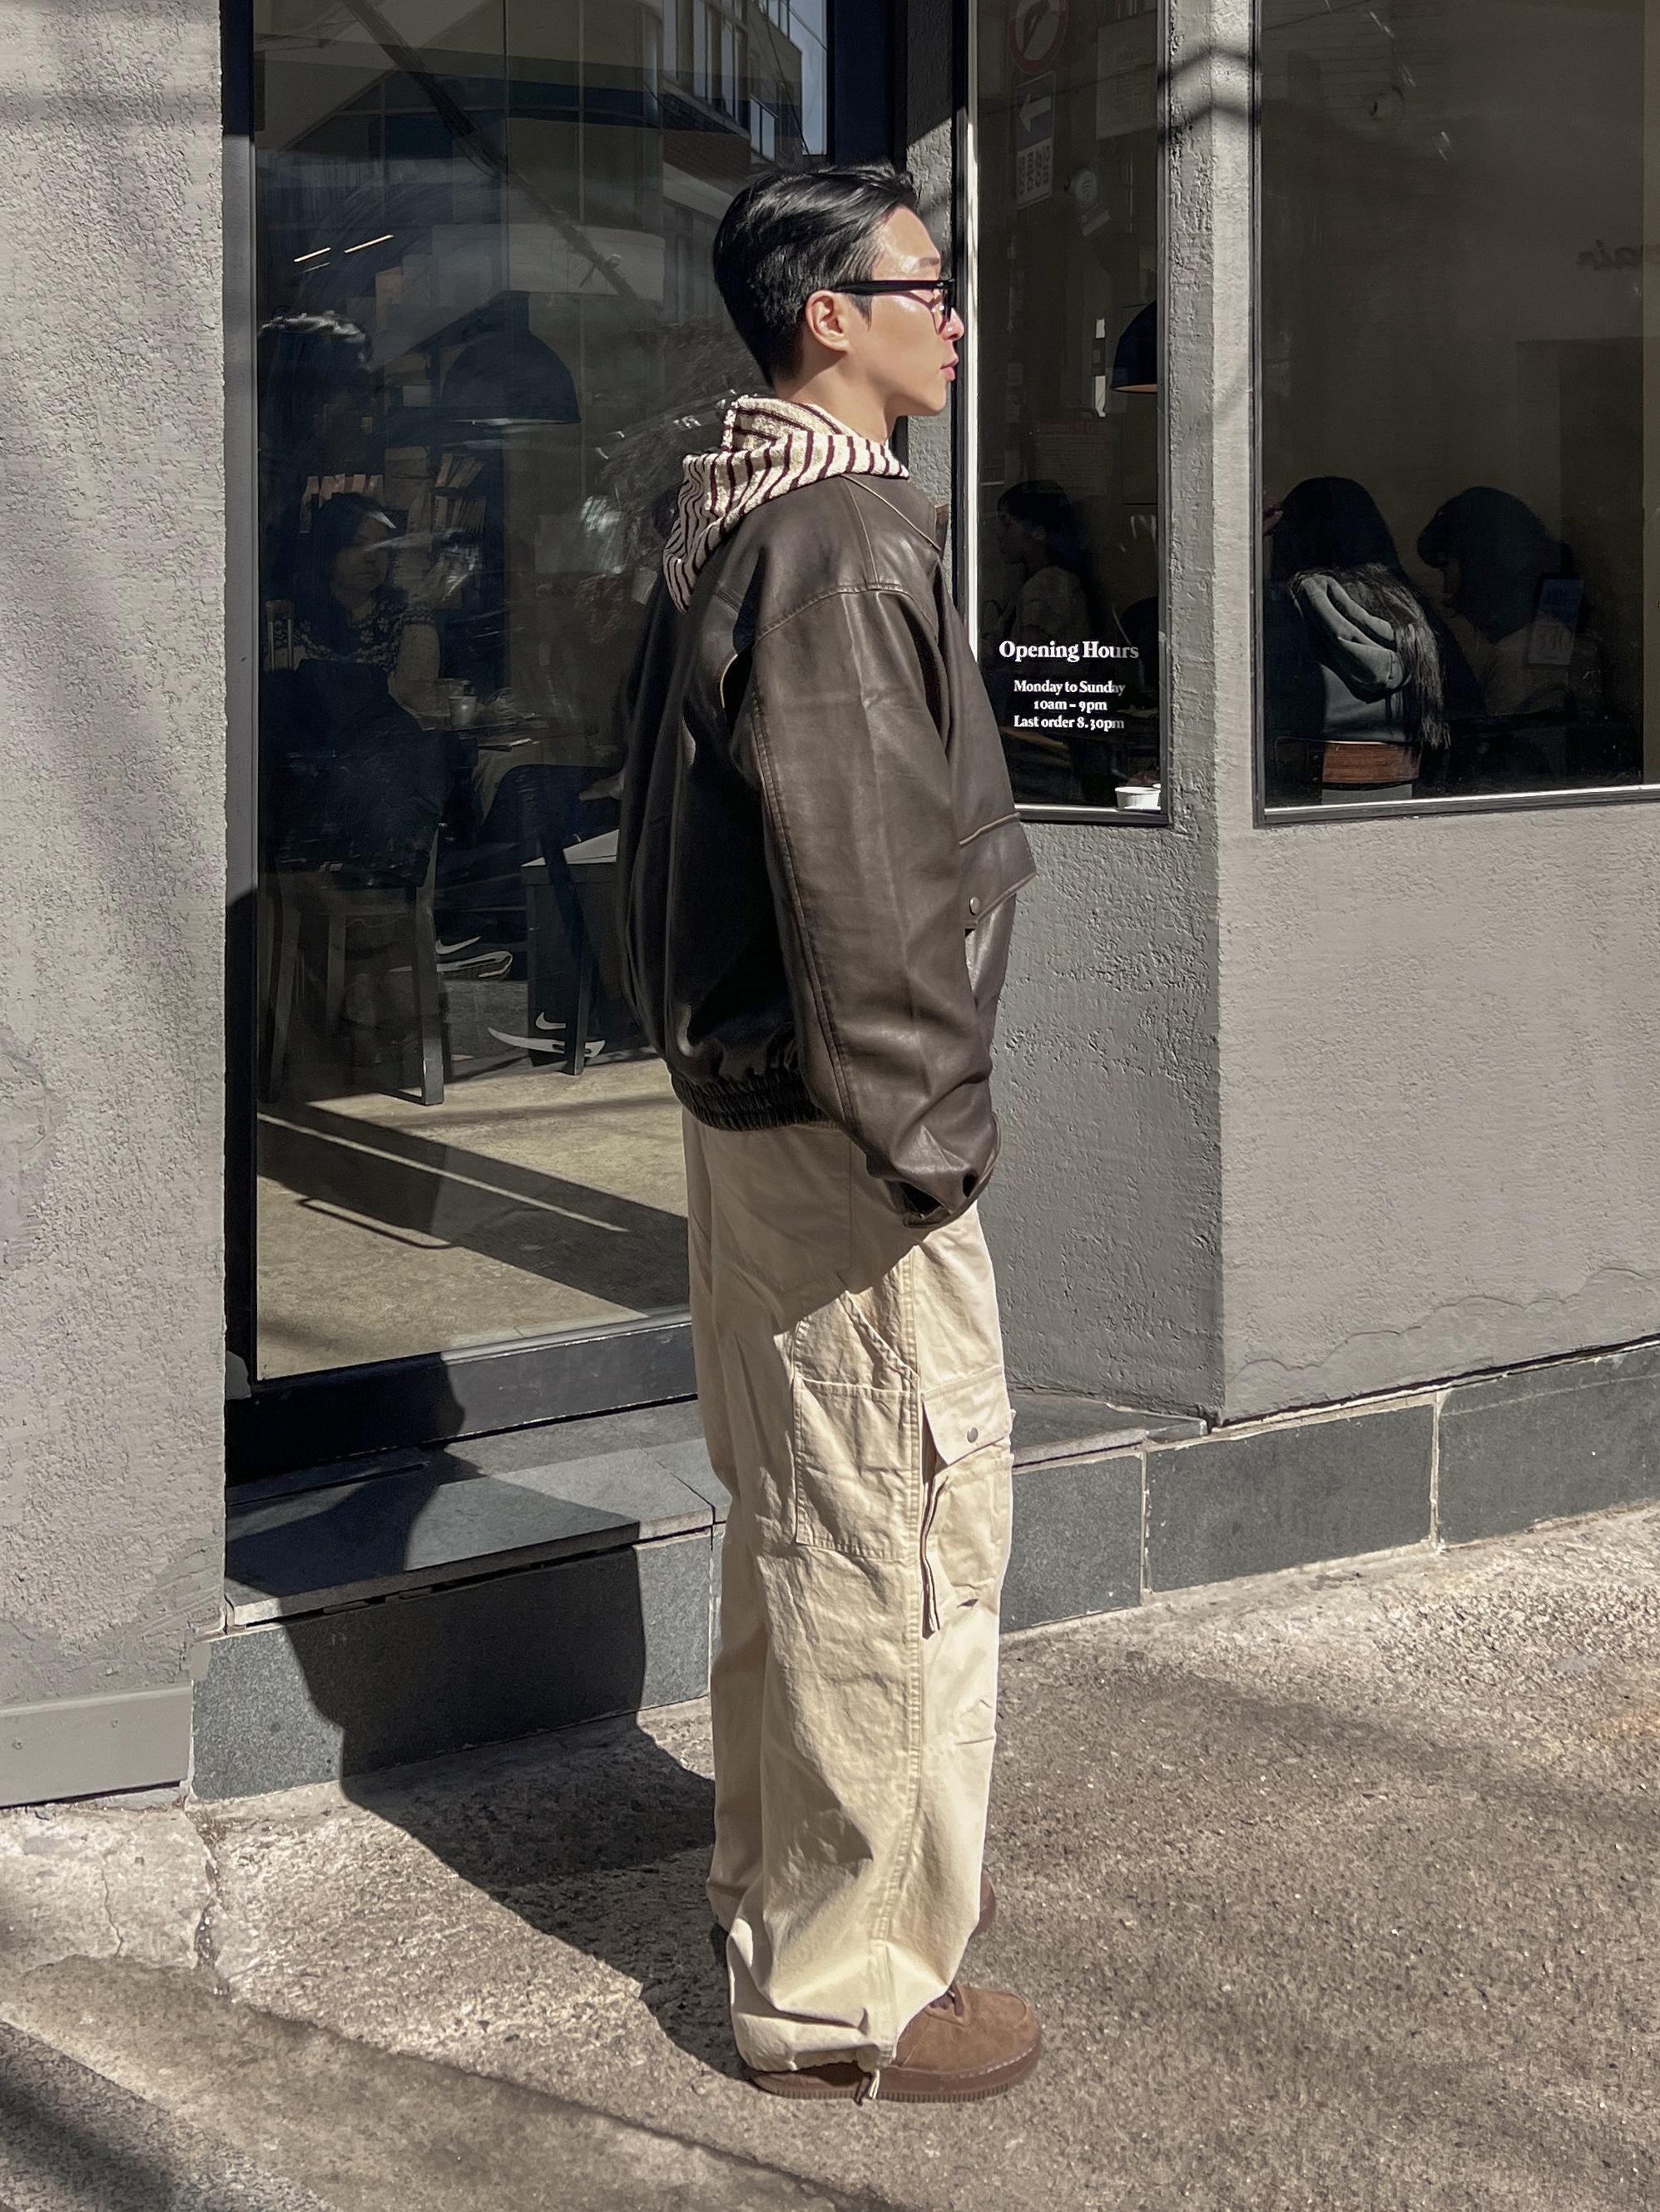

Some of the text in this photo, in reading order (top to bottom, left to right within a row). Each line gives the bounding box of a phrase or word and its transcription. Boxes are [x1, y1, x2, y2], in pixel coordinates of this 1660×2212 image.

[999, 641, 1139, 662] Opening Hours
[1013, 680, 1125, 696] Monday to Sunday
[1034, 700, 1067, 710] 10am
[1078, 701, 1107, 713] 9pm
[1014, 715, 1124, 732] Last order 8.30pm
